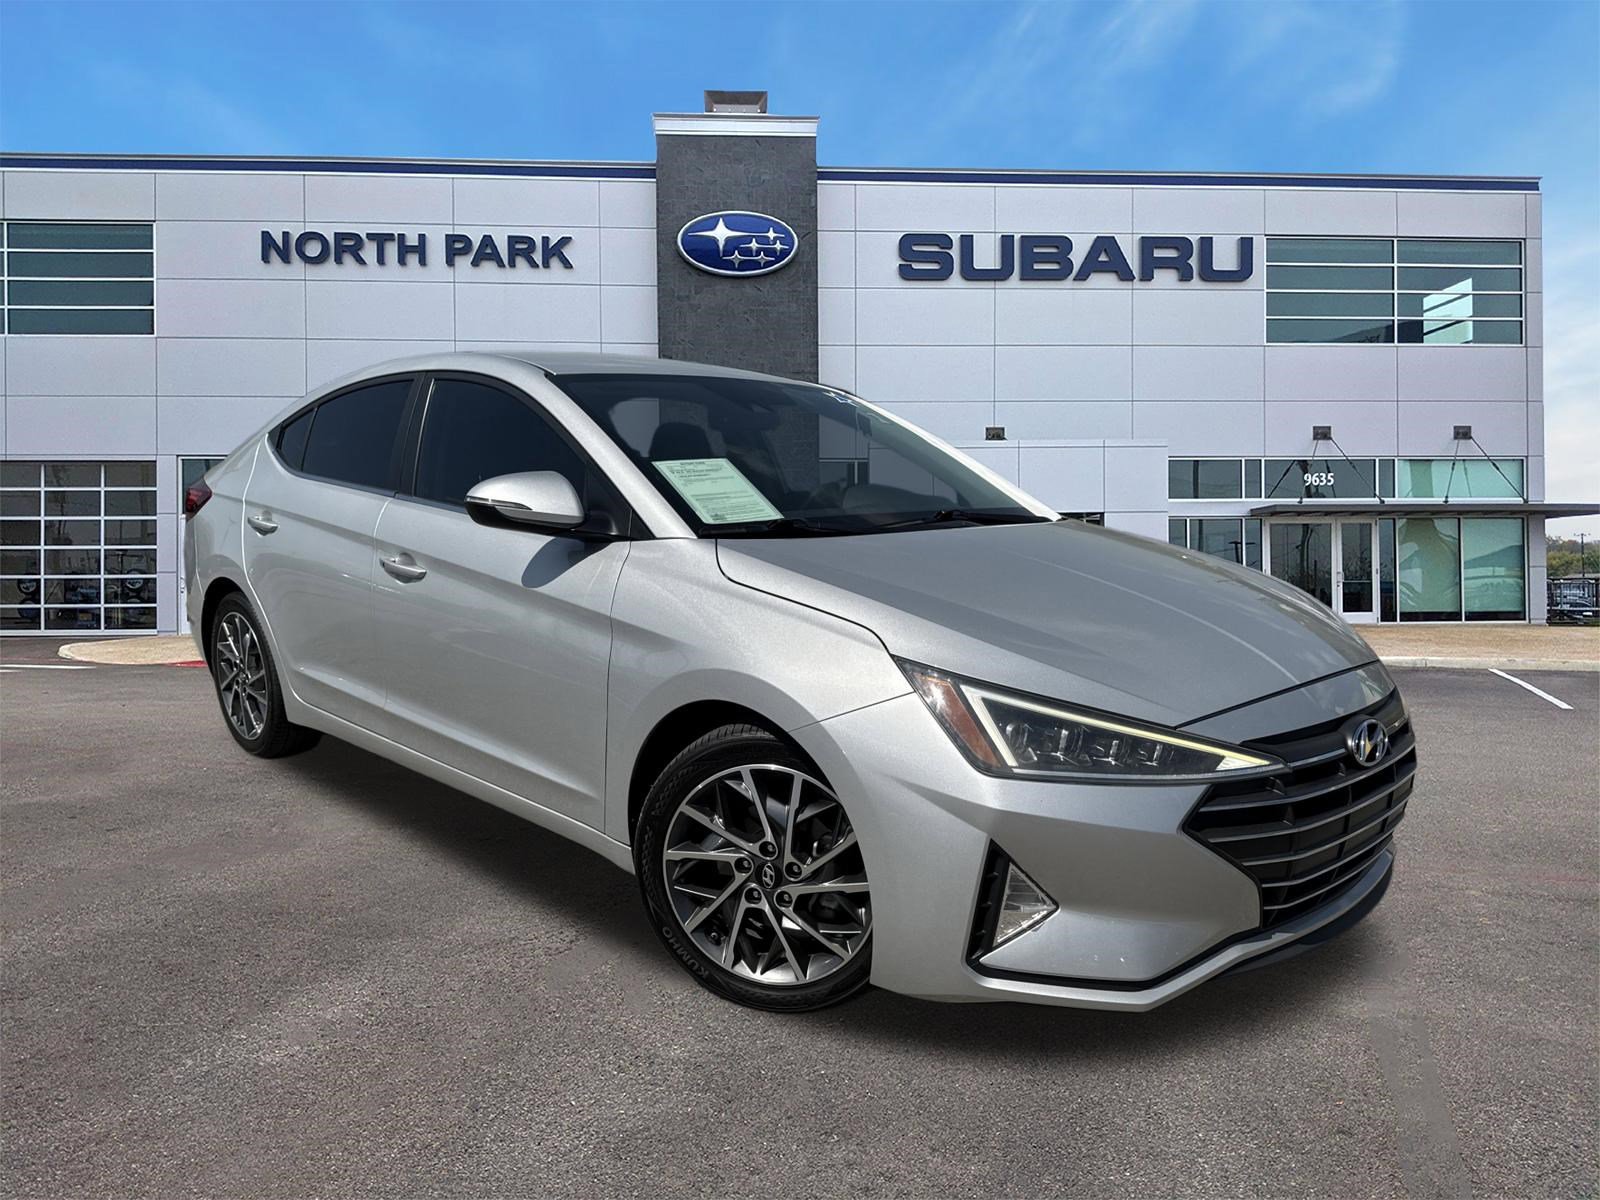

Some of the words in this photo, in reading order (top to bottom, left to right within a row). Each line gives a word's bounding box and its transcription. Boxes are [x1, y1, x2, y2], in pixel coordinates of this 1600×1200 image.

[261, 230, 427, 266] NORTH
[445, 233, 574, 269] PARK
[899, 233, 1254, 282] SUBARU
[1303, 472, 1335, 486] 9635
[662, 926, 709, 978] KUMHO
